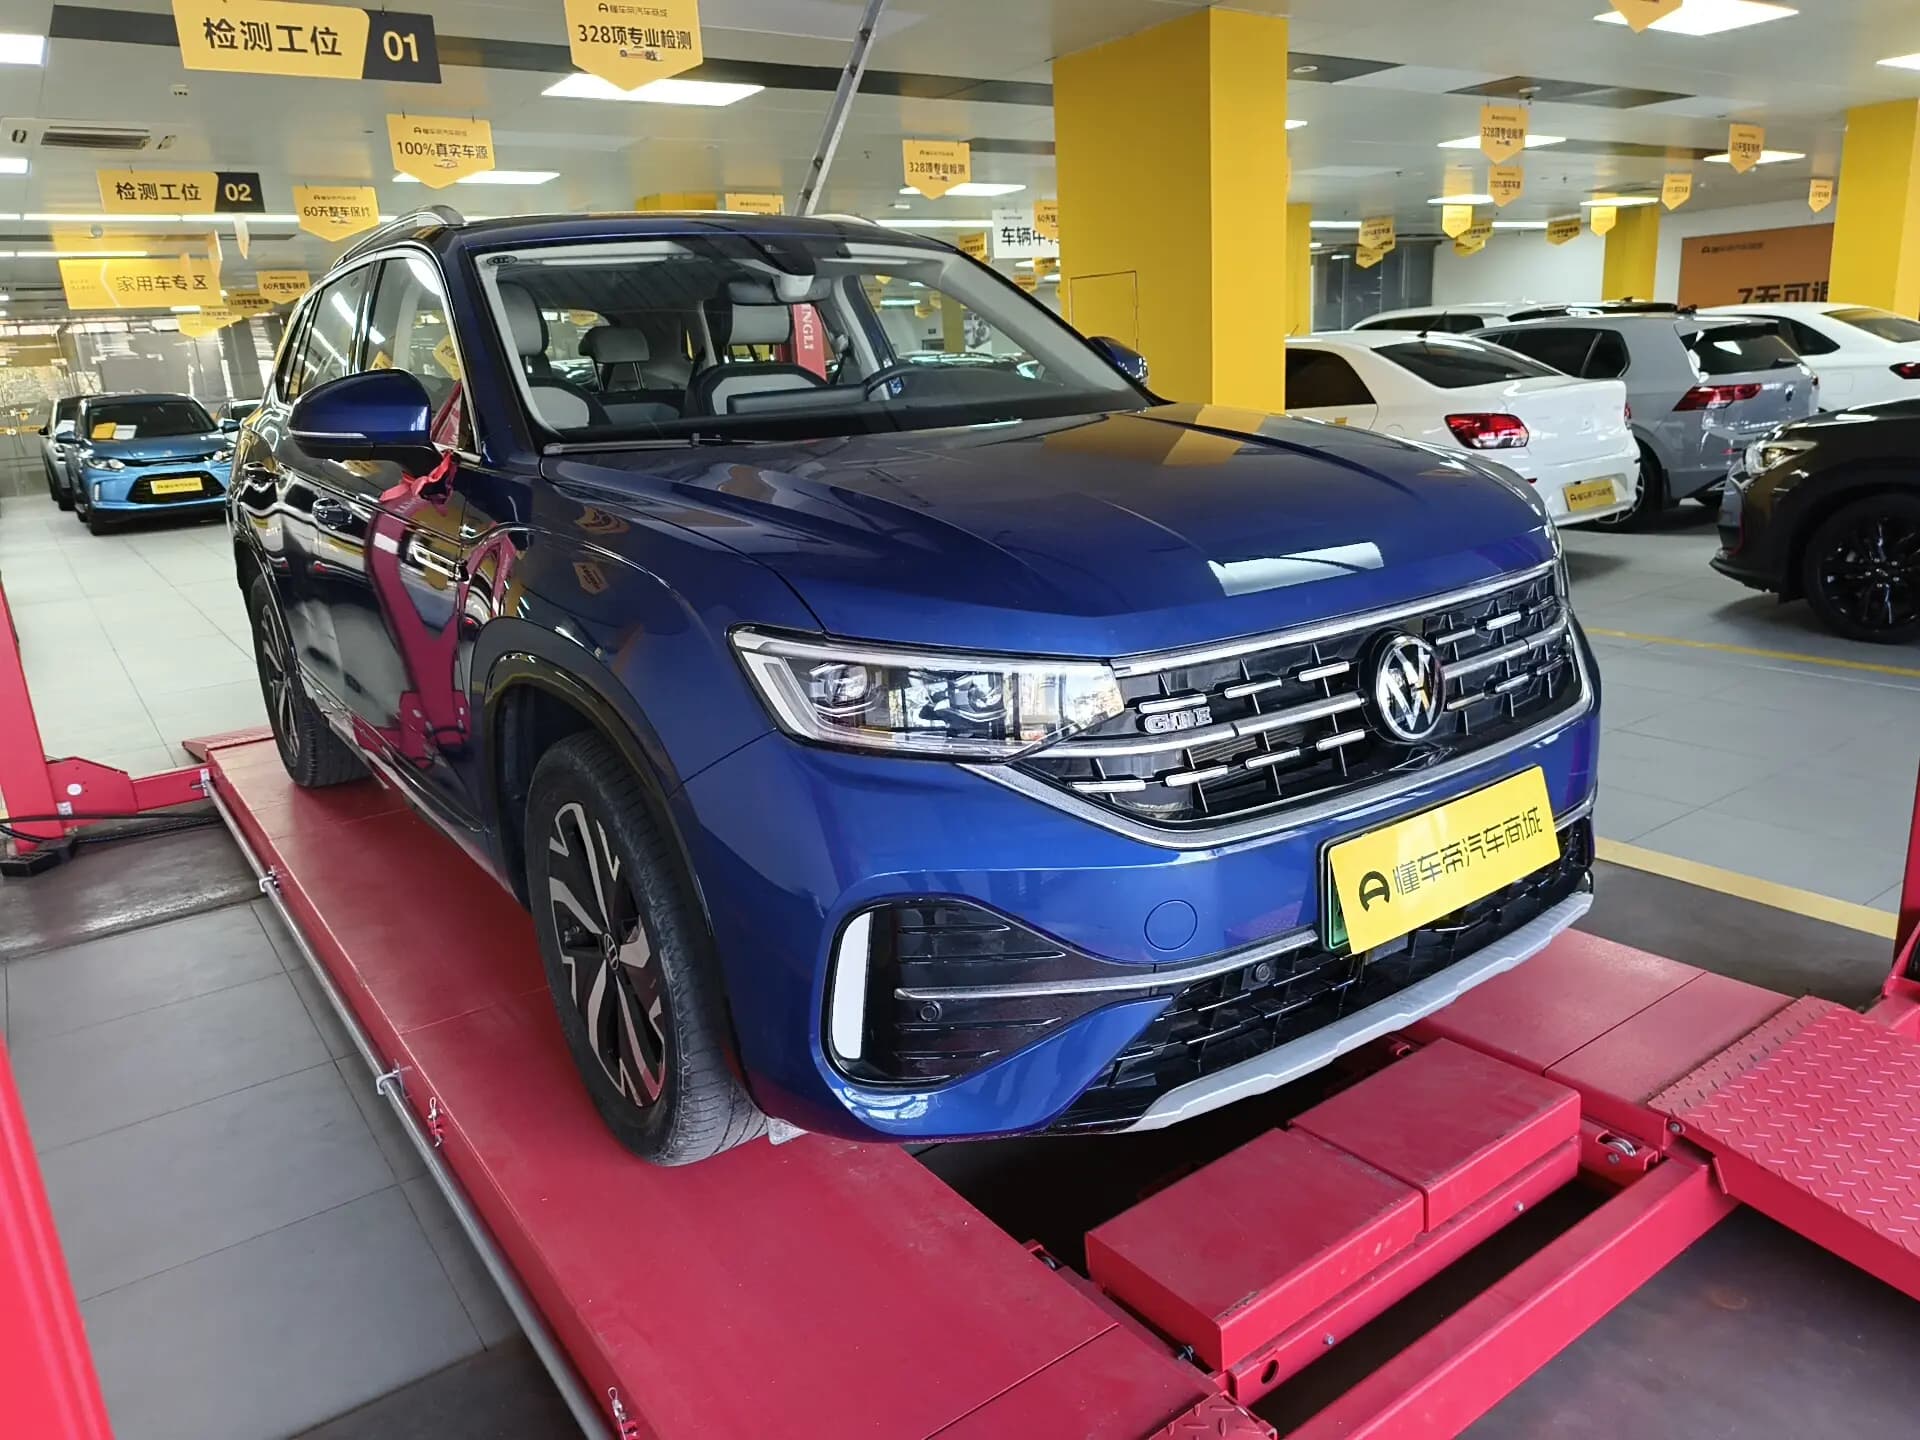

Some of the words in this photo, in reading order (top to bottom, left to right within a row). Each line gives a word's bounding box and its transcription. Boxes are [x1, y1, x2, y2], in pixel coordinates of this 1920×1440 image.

[203, 17, 342, 56] 检测工位
[382, 31, 419, 63] 01
[578, 24, 692, 50] 328项专业检测
[397, 141, 488, 159] 100%真实车源
[115, 182, 202, 201] 检测工位
[225, 183, 253, 202] 02
[1001, 221, 1060, 246] 车辆中
[115, 274, 208, 292] 家用车专区
[1391, 806, 1543, 896] 懂车帝汽车商城
